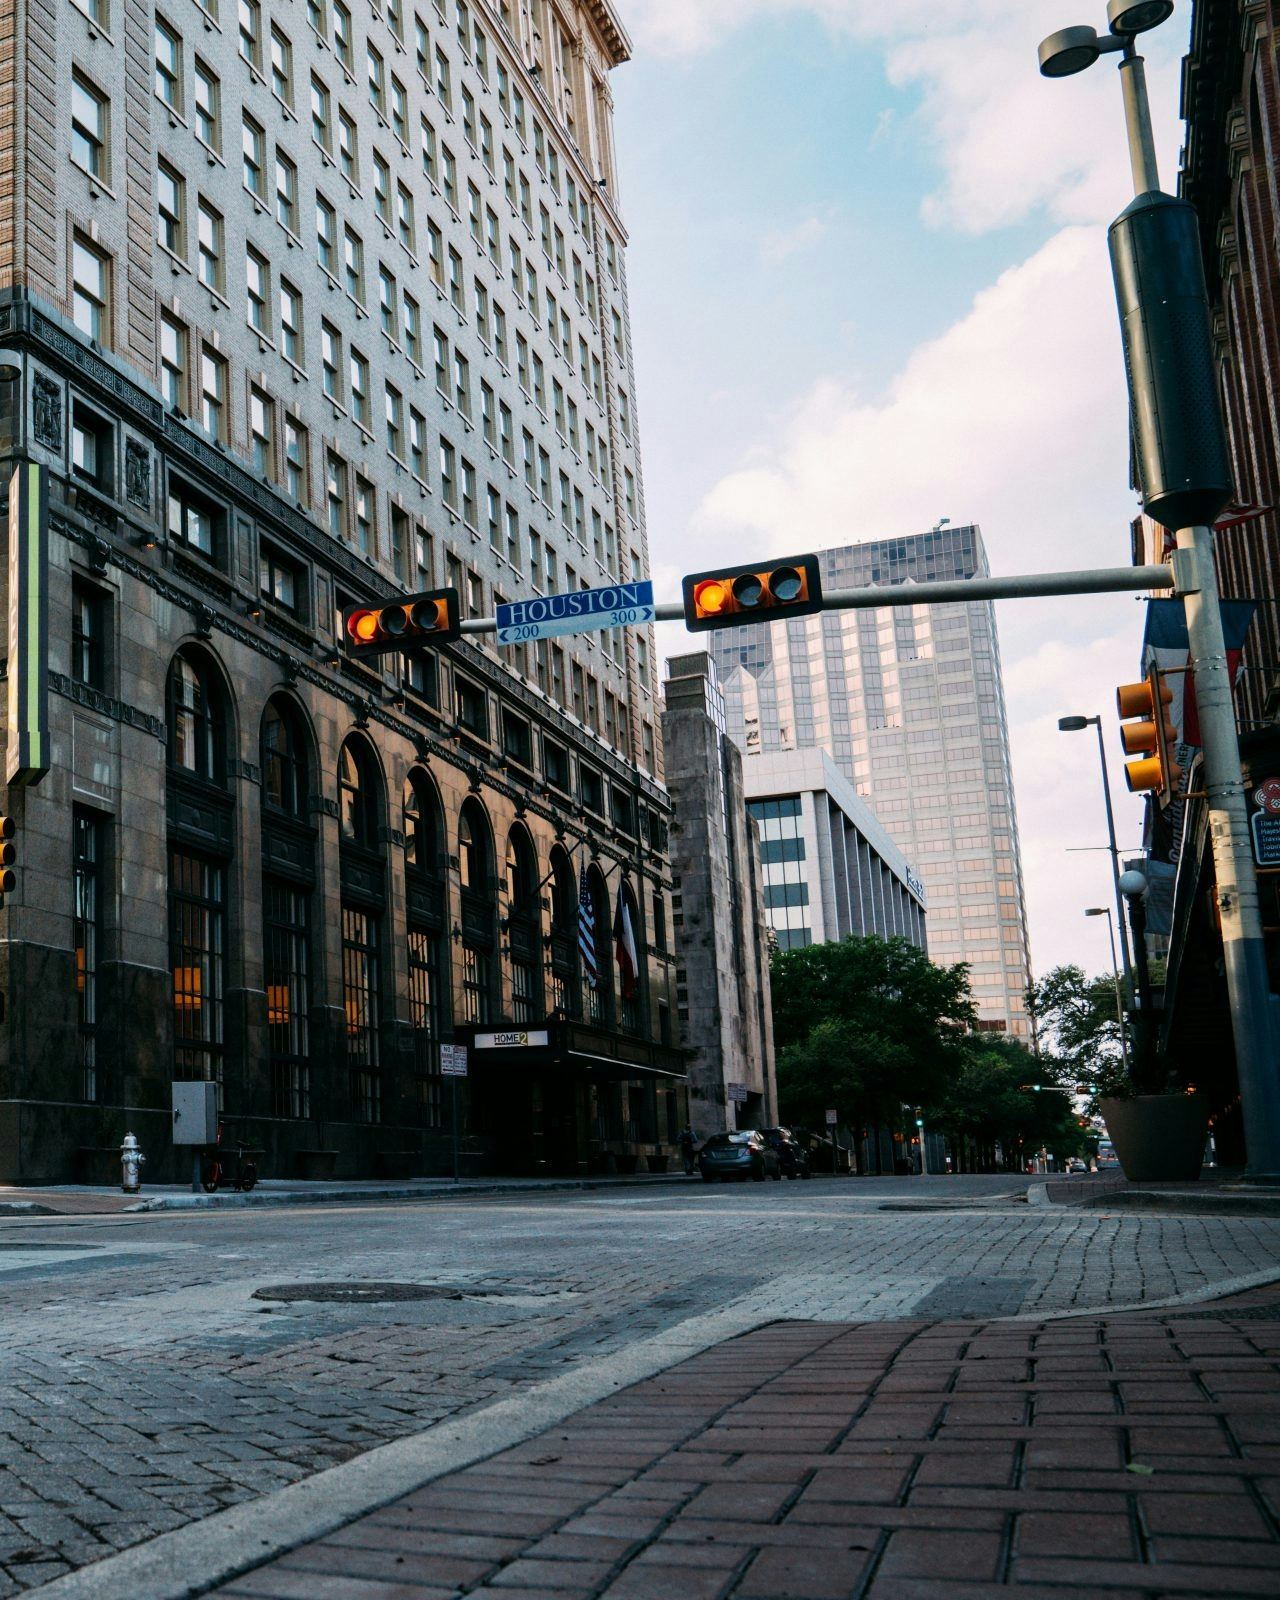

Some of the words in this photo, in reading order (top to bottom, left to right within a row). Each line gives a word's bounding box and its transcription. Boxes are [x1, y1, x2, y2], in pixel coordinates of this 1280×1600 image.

[509, 585, 641, 625] HOUSTON
[514, 624, 540, 641] 200
[610, 608, 637, 626] 300
